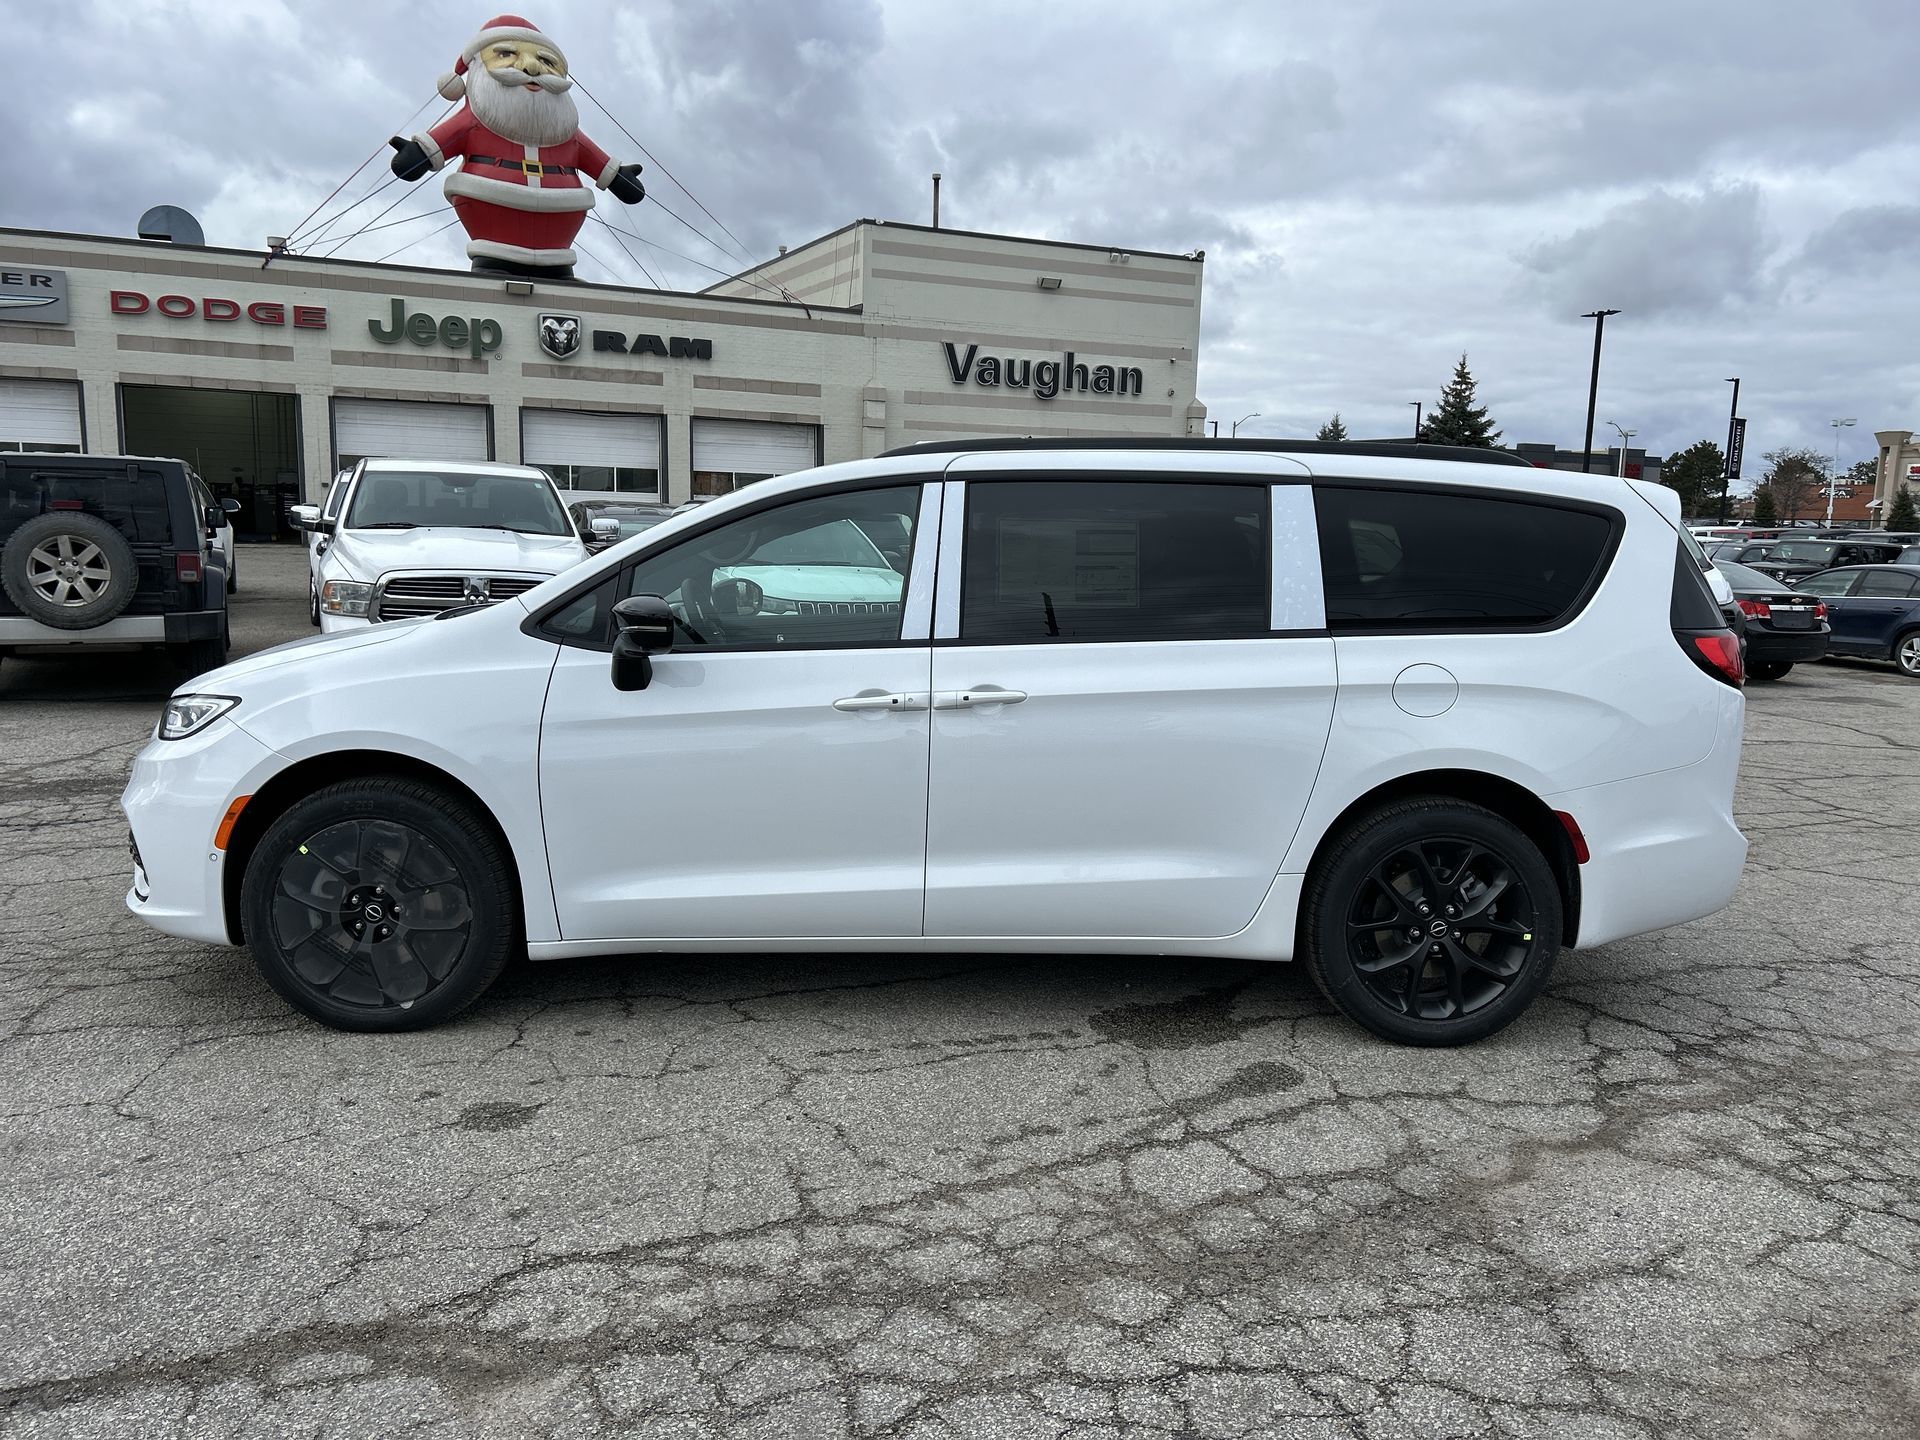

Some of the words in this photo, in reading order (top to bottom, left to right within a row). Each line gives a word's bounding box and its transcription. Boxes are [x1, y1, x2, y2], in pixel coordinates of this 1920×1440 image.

[110, 290, 328, 329] DODGE
[368, 298, 503, 359] Jeep
[593, 330, 713, 359] RAM
[942, 341, 1144, 400] Vaughan
[1733, 425, 1742, 462] DILAWRI
